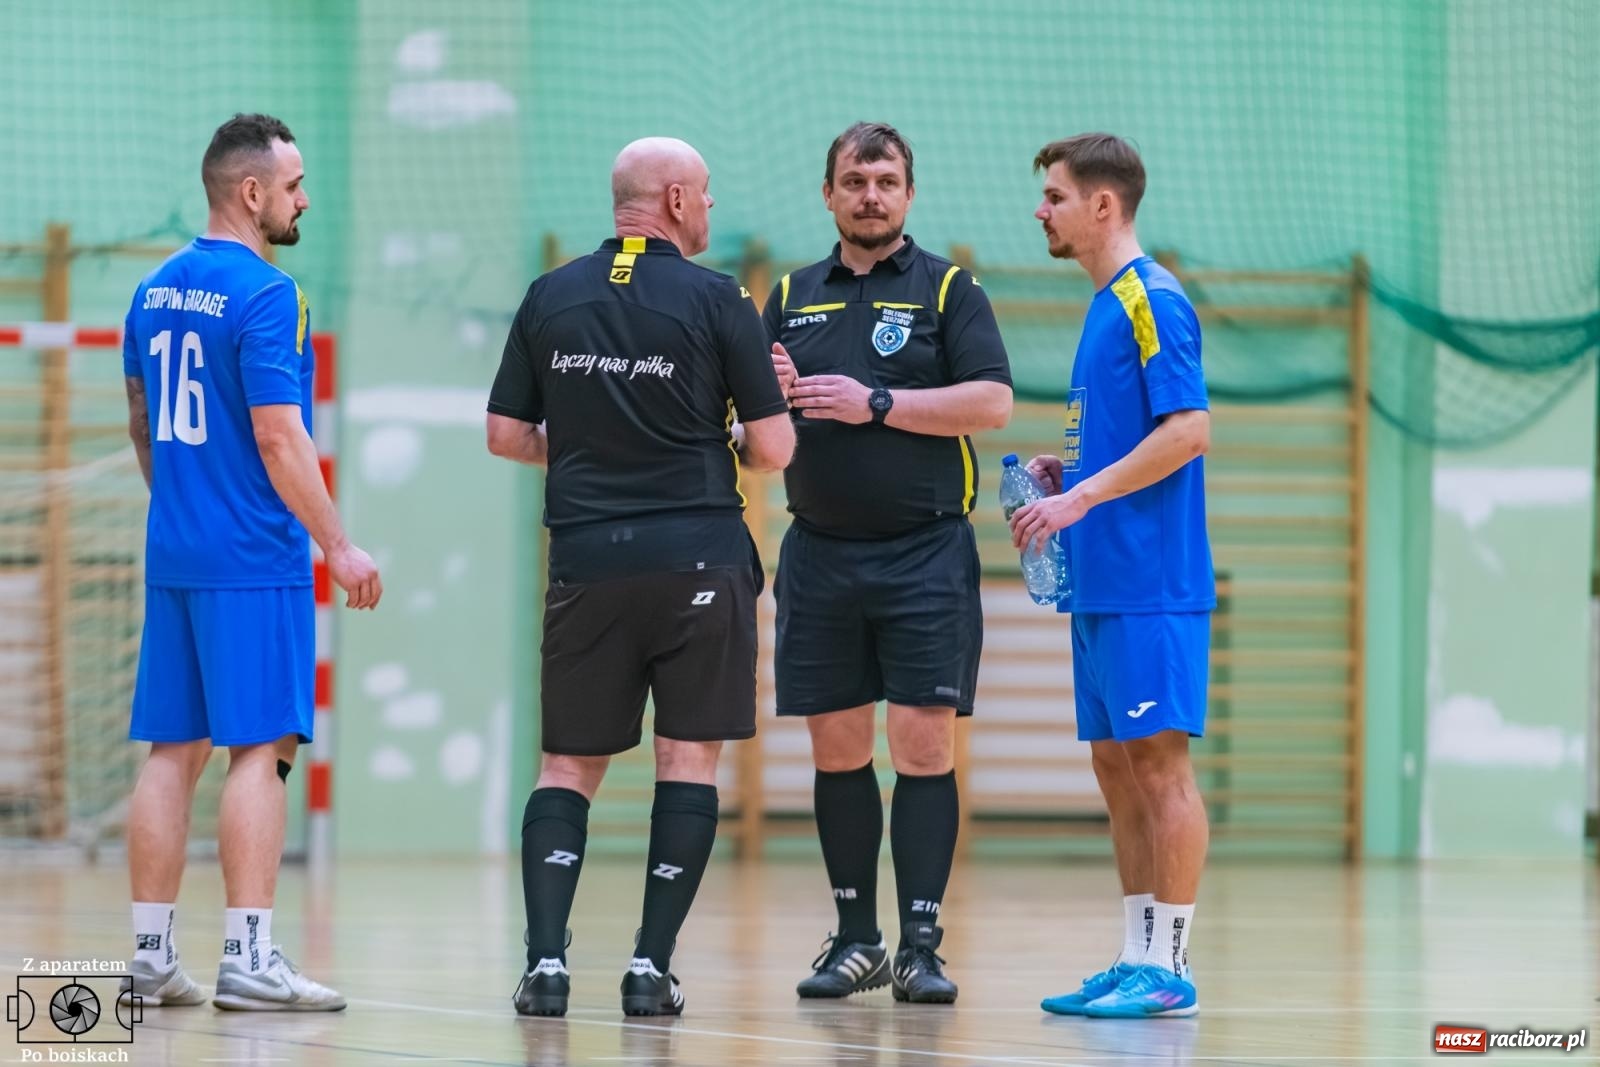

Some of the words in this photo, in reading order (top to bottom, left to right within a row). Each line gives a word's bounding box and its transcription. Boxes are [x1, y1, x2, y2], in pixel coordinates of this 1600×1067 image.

[184, 288, 229, 318] GARAGE
[551, 350, 597, 375] Łączy
[598, 356, 629, 373] nas
[629, 355, 675, 380] piłka
[149, 329, 208, 446] 16
